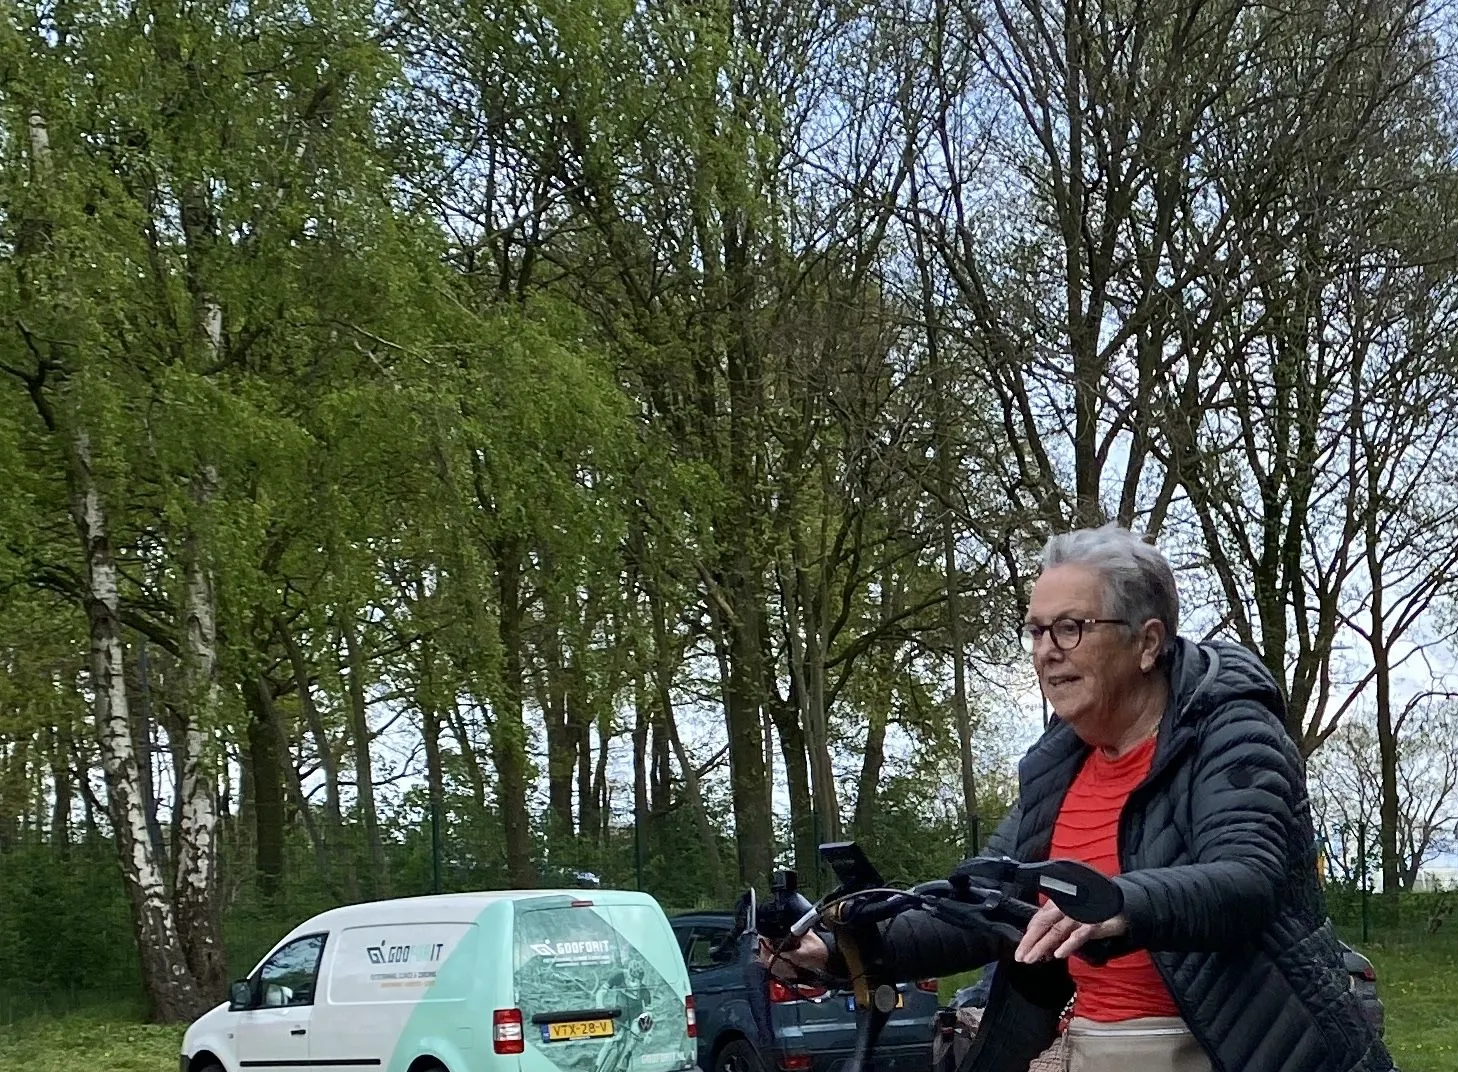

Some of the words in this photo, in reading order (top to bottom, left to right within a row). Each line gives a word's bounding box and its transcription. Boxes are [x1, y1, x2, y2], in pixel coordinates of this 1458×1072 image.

[388, 943, 444, 963] GOOIT
[556, 940, 609, 955] GOOFORIT
[553, 1022, 607, 1037] VTX-28-V
